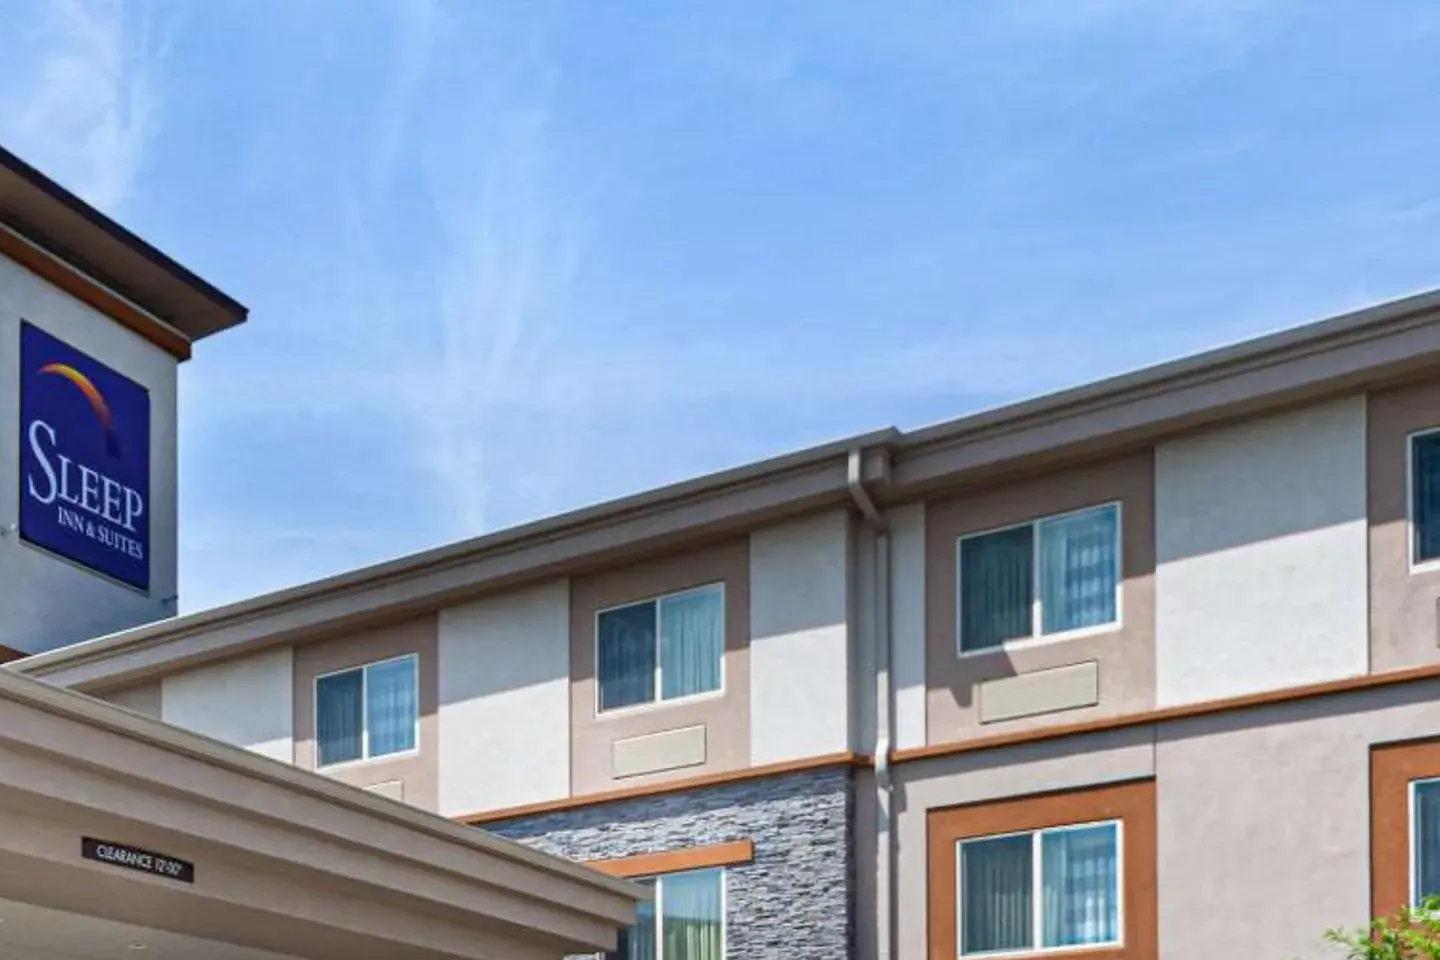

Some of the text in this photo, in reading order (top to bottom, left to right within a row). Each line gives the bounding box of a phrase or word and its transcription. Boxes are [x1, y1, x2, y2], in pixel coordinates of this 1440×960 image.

[29, 420, 143, 531] SLEEP
[58, 506, 143, 559] INN & SUITES
[96, 844, 152, 868] CLEARANCE
